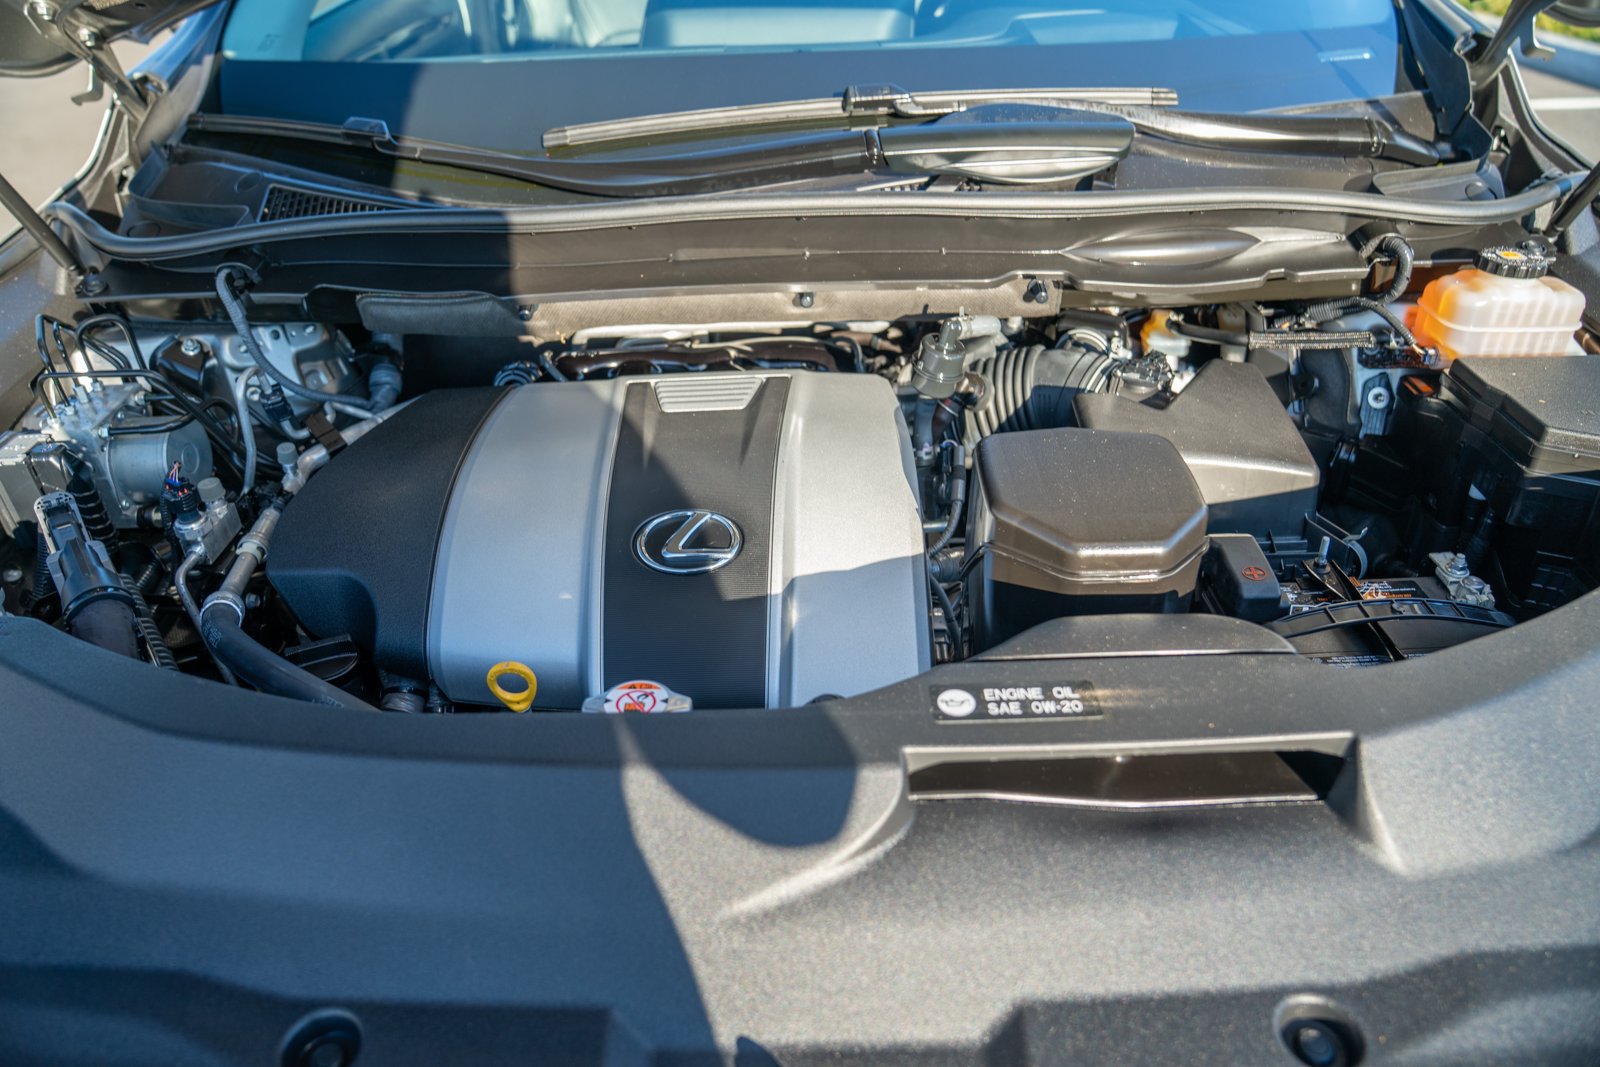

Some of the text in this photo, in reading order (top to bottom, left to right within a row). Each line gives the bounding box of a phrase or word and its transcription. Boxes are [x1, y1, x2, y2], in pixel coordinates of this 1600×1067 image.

[983, 686, 1080, 701] ENGINE OIL
[987, 699, 1084, 716] SAE 0W-20
